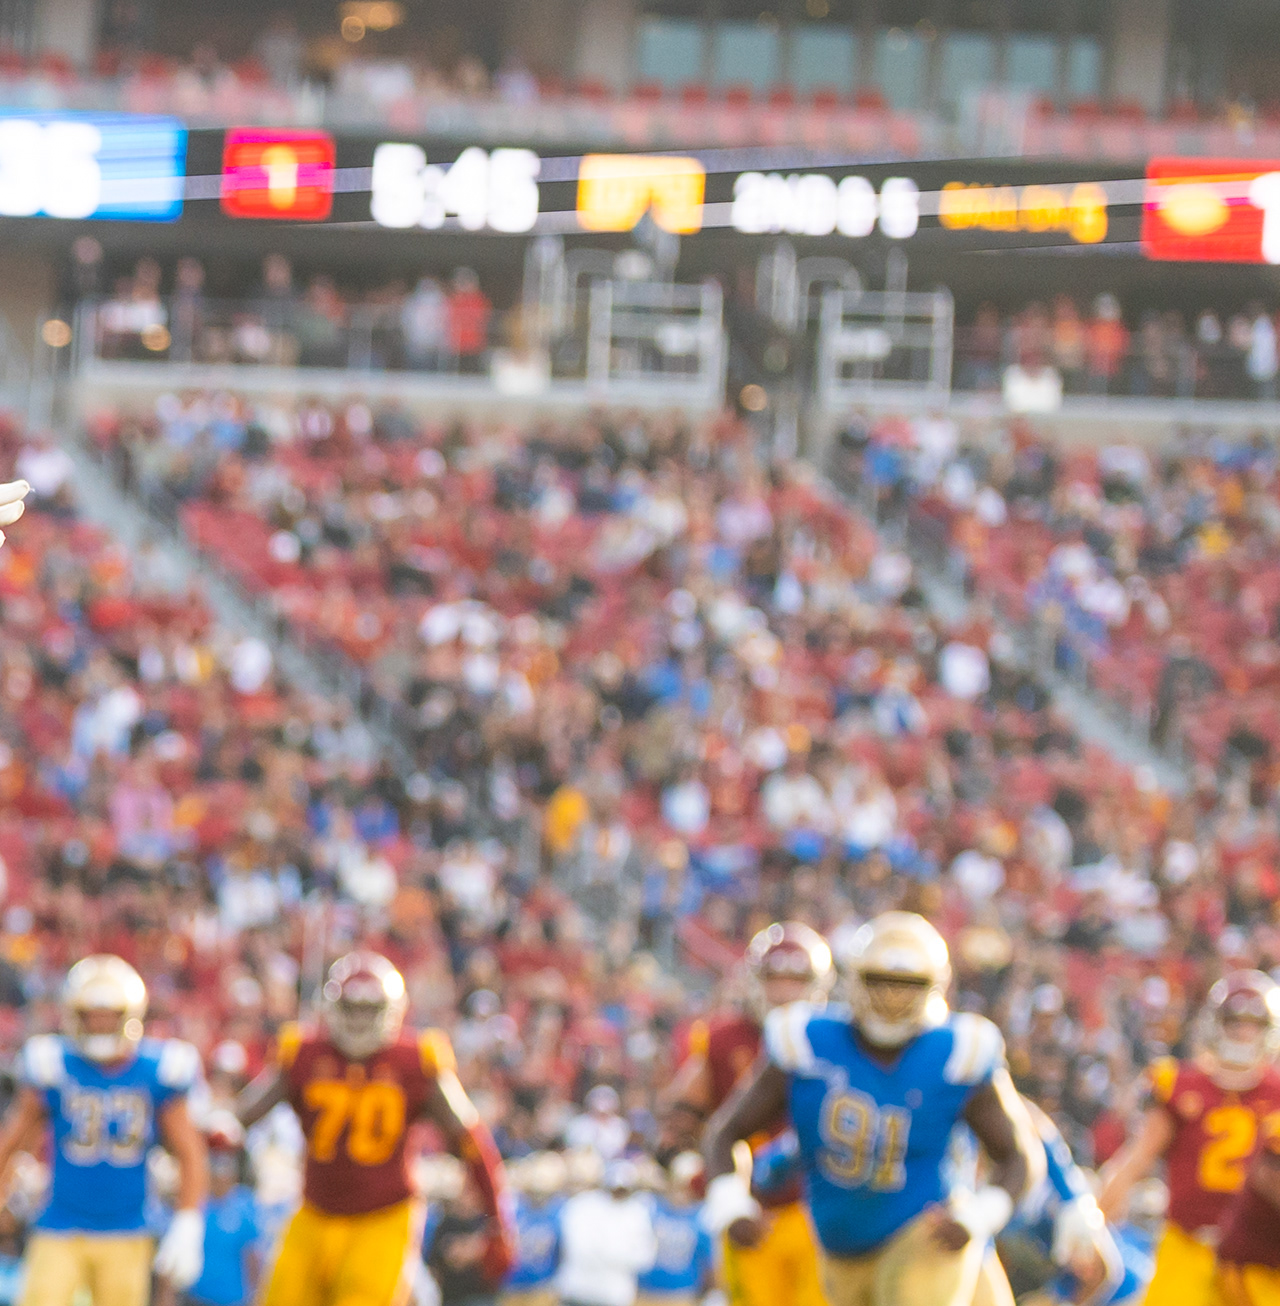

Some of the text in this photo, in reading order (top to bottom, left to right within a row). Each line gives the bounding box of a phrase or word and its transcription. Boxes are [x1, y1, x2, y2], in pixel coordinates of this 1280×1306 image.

[60, 1084, 154, 1169] 33
[302, 1080, 408, 1167] 70
[816, 1086, 913, 1194] 91
